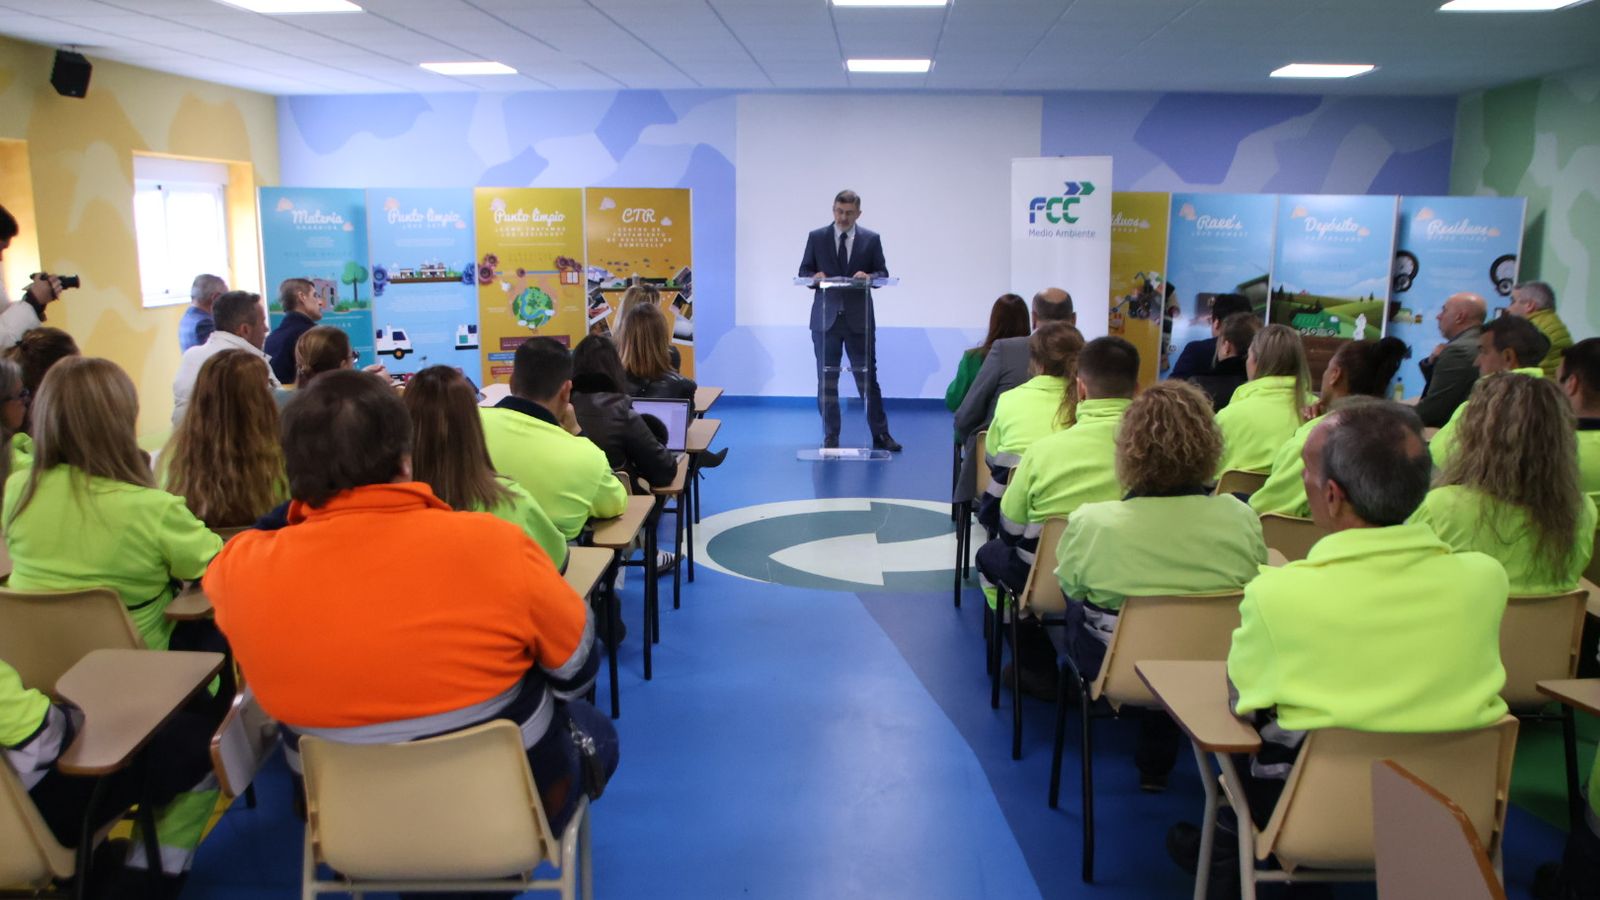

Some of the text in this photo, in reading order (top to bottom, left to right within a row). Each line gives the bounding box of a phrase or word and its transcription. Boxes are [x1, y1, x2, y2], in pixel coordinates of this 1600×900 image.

[291, 209, 344, 224] Materia
[387, 207, 461, 228] Punto limpio
[494, 207, 566, 227] Punto limpio
[621, 207, 657, 223] CTR
[1029, 197, 1081, 224] FCC
[1029, 228, 1096, 238] Medio Ambiente
[1427, 218, 1489, 235] Residuos
